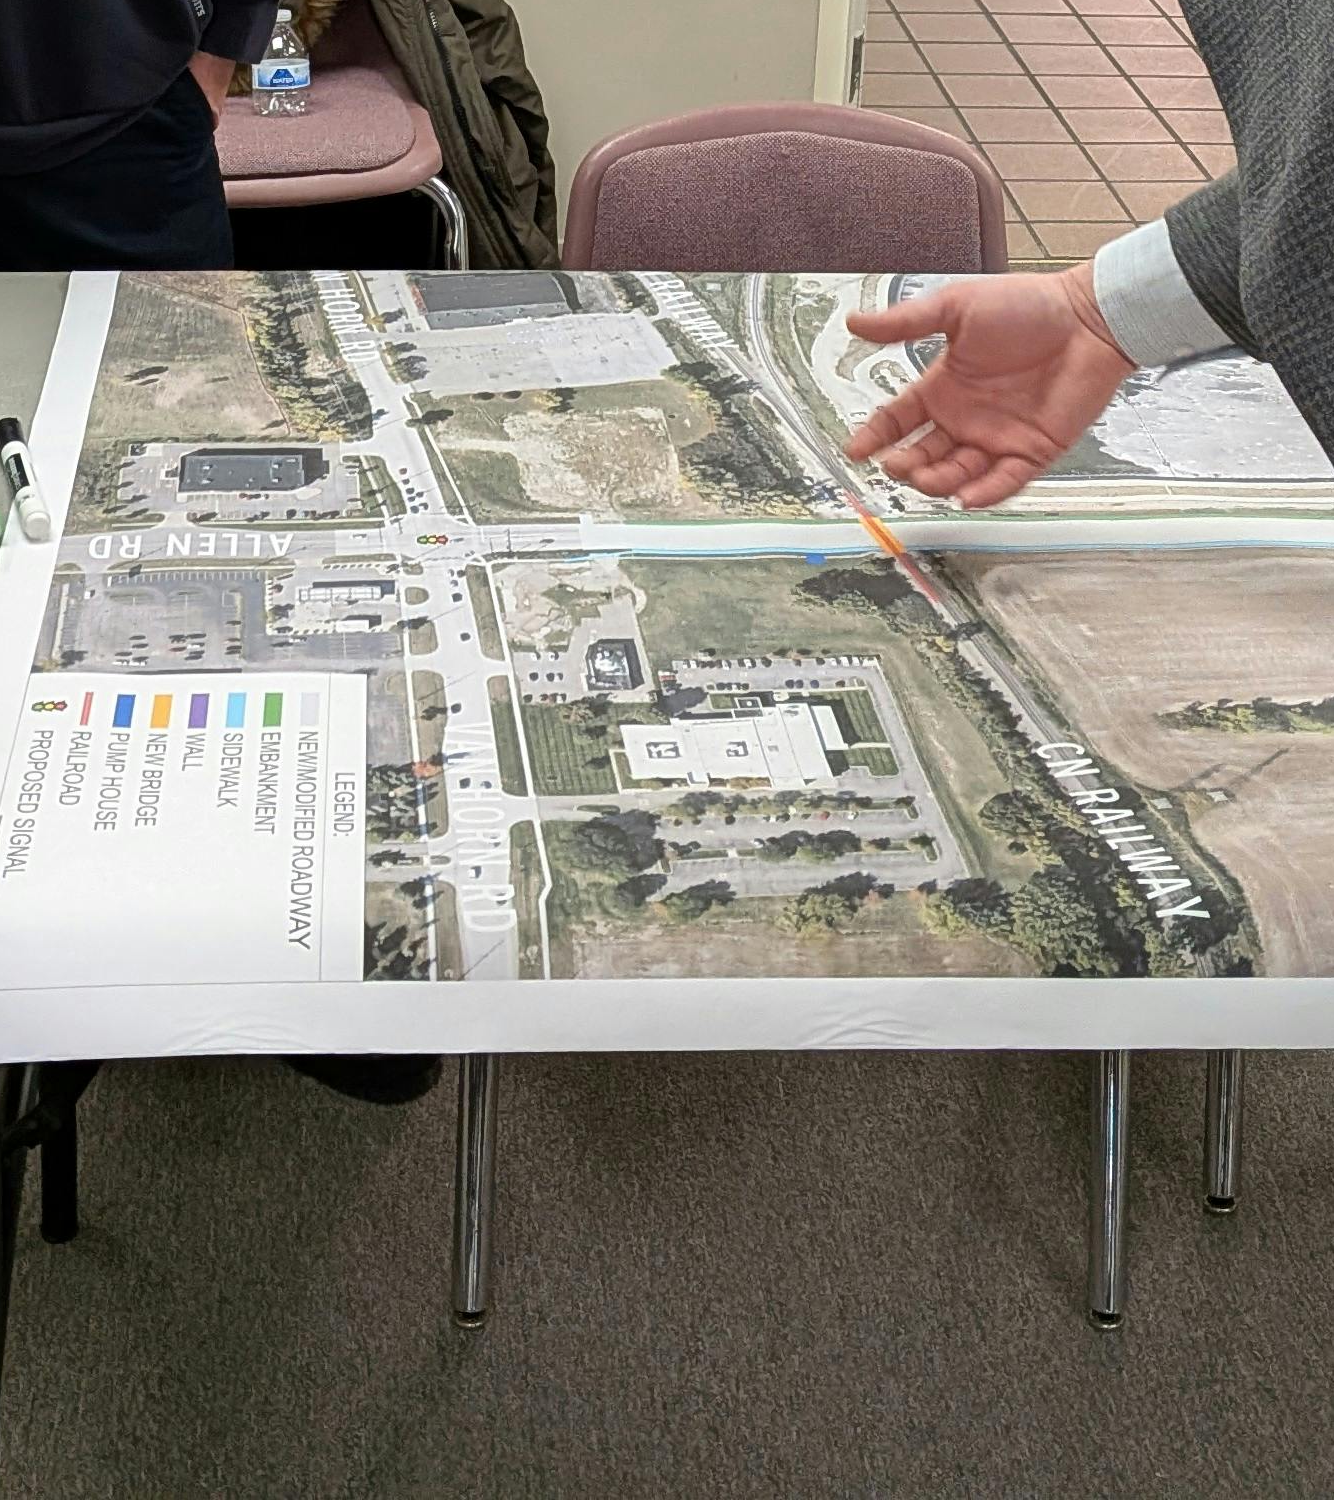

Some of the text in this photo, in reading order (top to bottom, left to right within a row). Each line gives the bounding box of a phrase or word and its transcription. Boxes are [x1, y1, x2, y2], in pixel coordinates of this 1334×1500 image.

[318, 288, 370, 336] HORN
[649, 279, 740, 349] RAILWAY
[337, 339, 380, 363] RD
[87, 532, 295, 560] ALLEN RD
[58, 730, 93, 806] RAILROAD
[93, 731, 131, 831] PUMP HOUSE
[134, 732, 169, 827] NEW BRIDGE
[181, 732, 207, 772] WALL
[216, 732, 244, 808] SIDEWALK
[254, 731, 282, 835] EMBANKMENT
[2, 729, 55, 879] PROPOSED SIGNAL
[288, 730, 319, 950] NEW/MODIFIED ROADWAY
[333, 771, 356, 837] LEGEND:
[1035, 741, 1211, 919] CN RAILWAY
